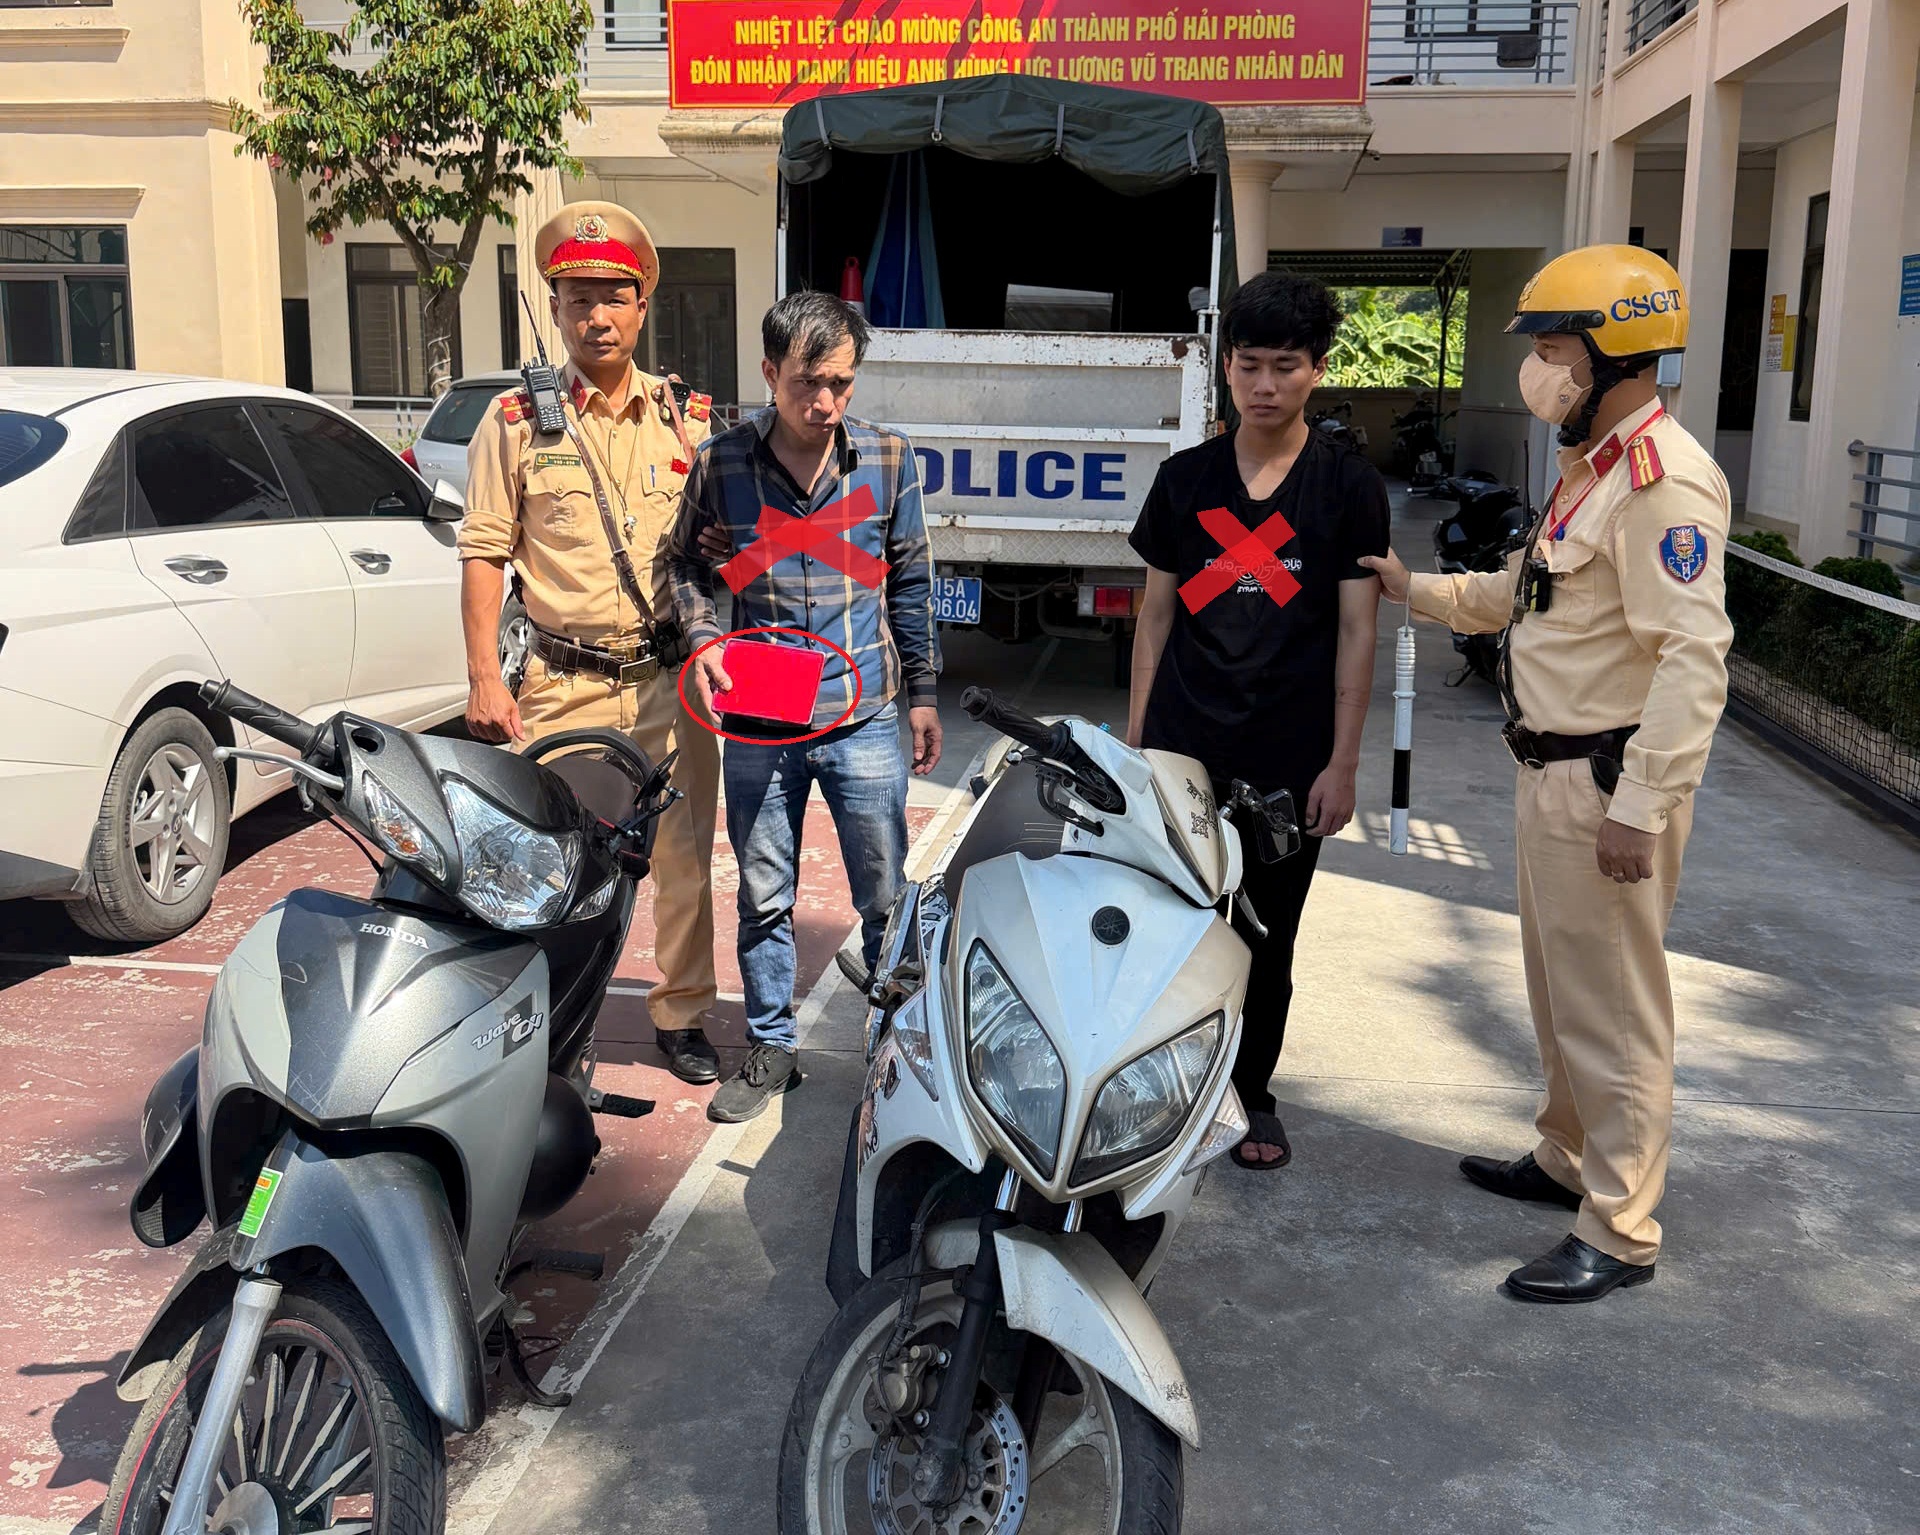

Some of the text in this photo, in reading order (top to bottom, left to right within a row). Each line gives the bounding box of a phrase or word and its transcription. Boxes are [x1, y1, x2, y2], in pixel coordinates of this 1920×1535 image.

[735, 7, 1296, 50] NHIỆT LIỆT CHÀO MỪNG CÔNG AN THÀNH PHỐ HẢI PHÒNG
[690, 55, 731, 84] ĐÓN
[737, 54, 792, 89] NHẬN
[797, 59, 849, 84] DANH
[856, 54, 901, 89] HIỆU
[906, 58, 948, 84] ANH
[953, 53, 1008, 79] HÙNG
[1131, 52, 1156, 81] VŨ
[1163, 56, 1229, 81] TRANG
[1235, 50, 1294, 80] NHÂN
[1301, 49, 1344, 79] DÂN
[1610, 289, 1681, 322] CSGT
[913, 447, 1126, 501] OLICE
[935, 577, 965, 598] 15A
[934, 598, 977, 620] 06.04
[359, 922, 429, 950] HONDA
